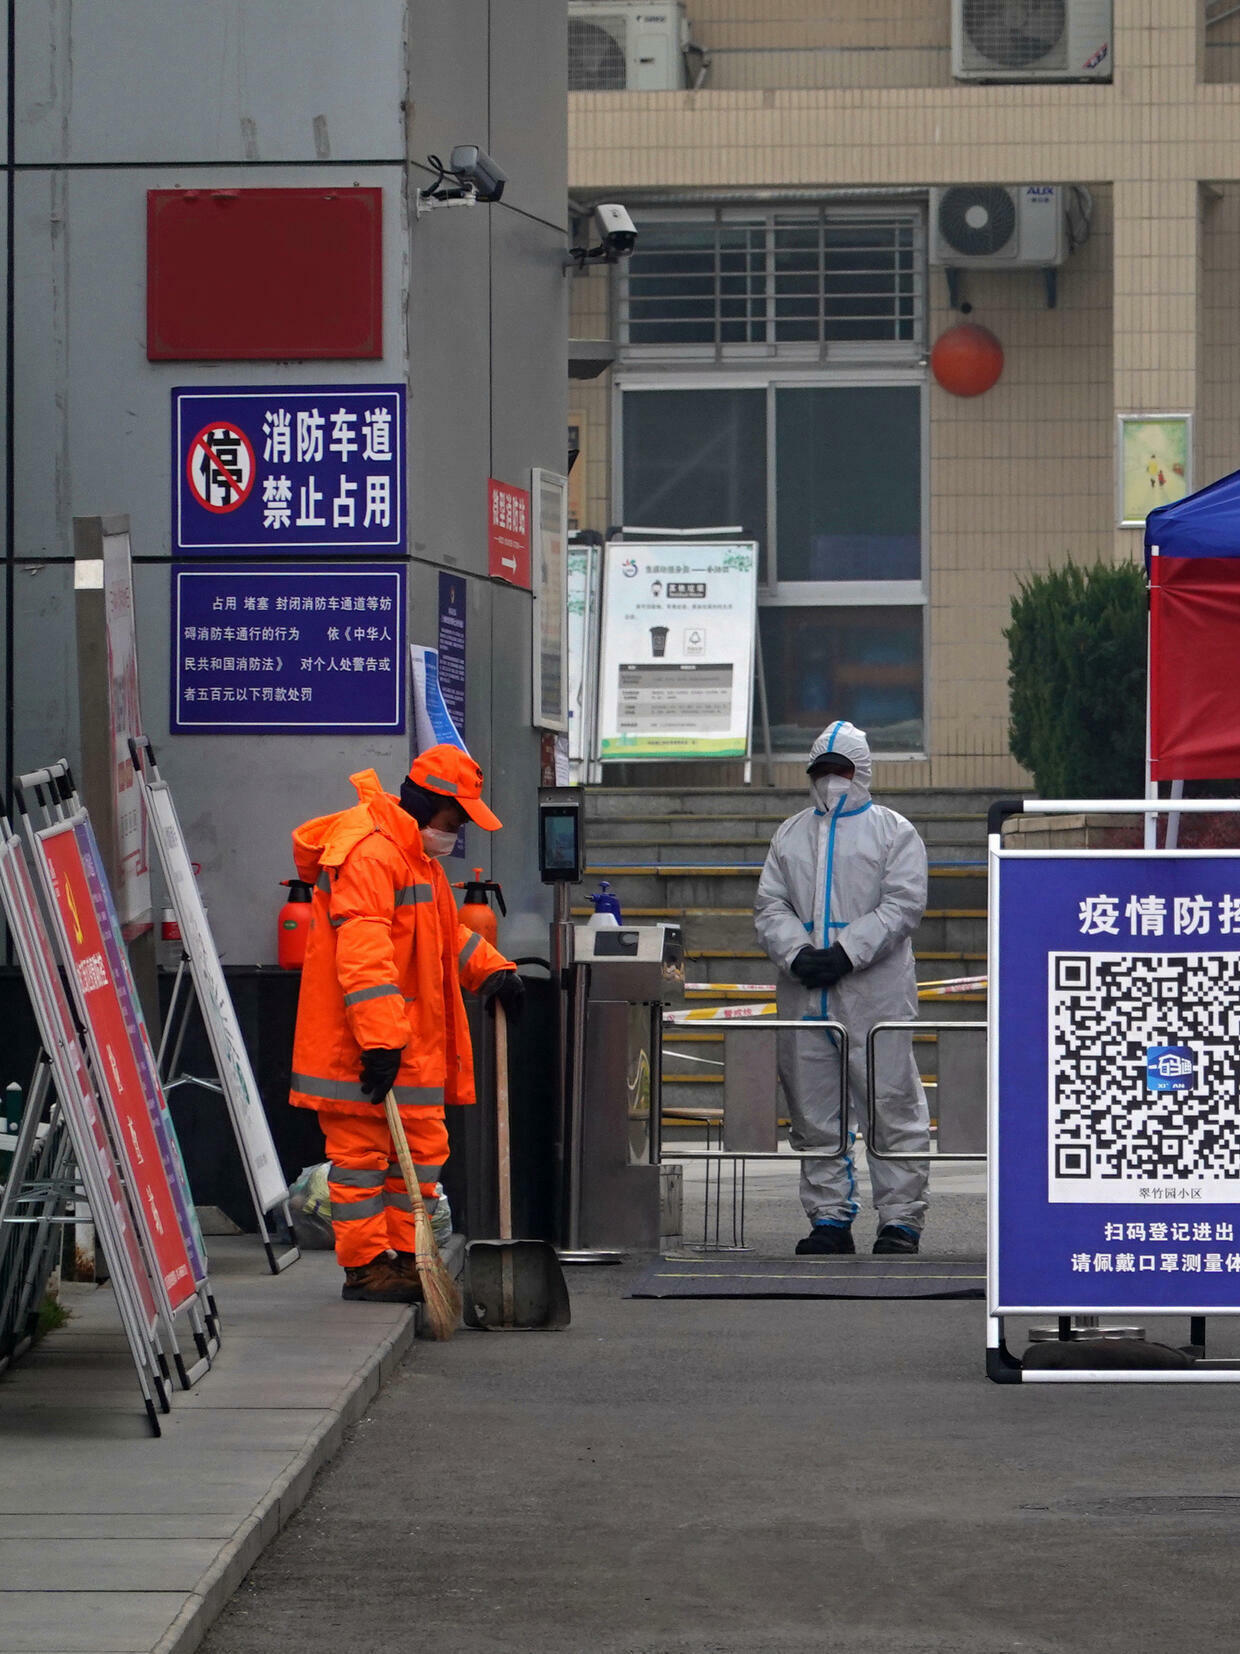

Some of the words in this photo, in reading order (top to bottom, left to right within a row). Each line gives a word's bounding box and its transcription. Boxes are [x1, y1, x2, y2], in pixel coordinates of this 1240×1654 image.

[262, 407, 392, 463] 消防车道
[200, 429, 243, 506] 停
[262, 474, 391, 530] 禁止占用
[212, 596, 237, 611] 占用
[244, 596, 270, 611] 堵塞
[275, 596, 393, 611] 封闭消防车通道等妨
[184, 626, 300, 641] 碍消防车通行的行为
[327, 626, 392, 641] 依《中华人
[184, 657, 284, 672] 民共和国消防法》
[300, 657, 391, 672] 对个人处警告或
[184, 687, 313, 702] 者五百元以下罚款处罚
[1138, 1187, 1203, 1199] 翠竹园小区
[1104, 1222, 1235, 1242] 扫码登记进出
